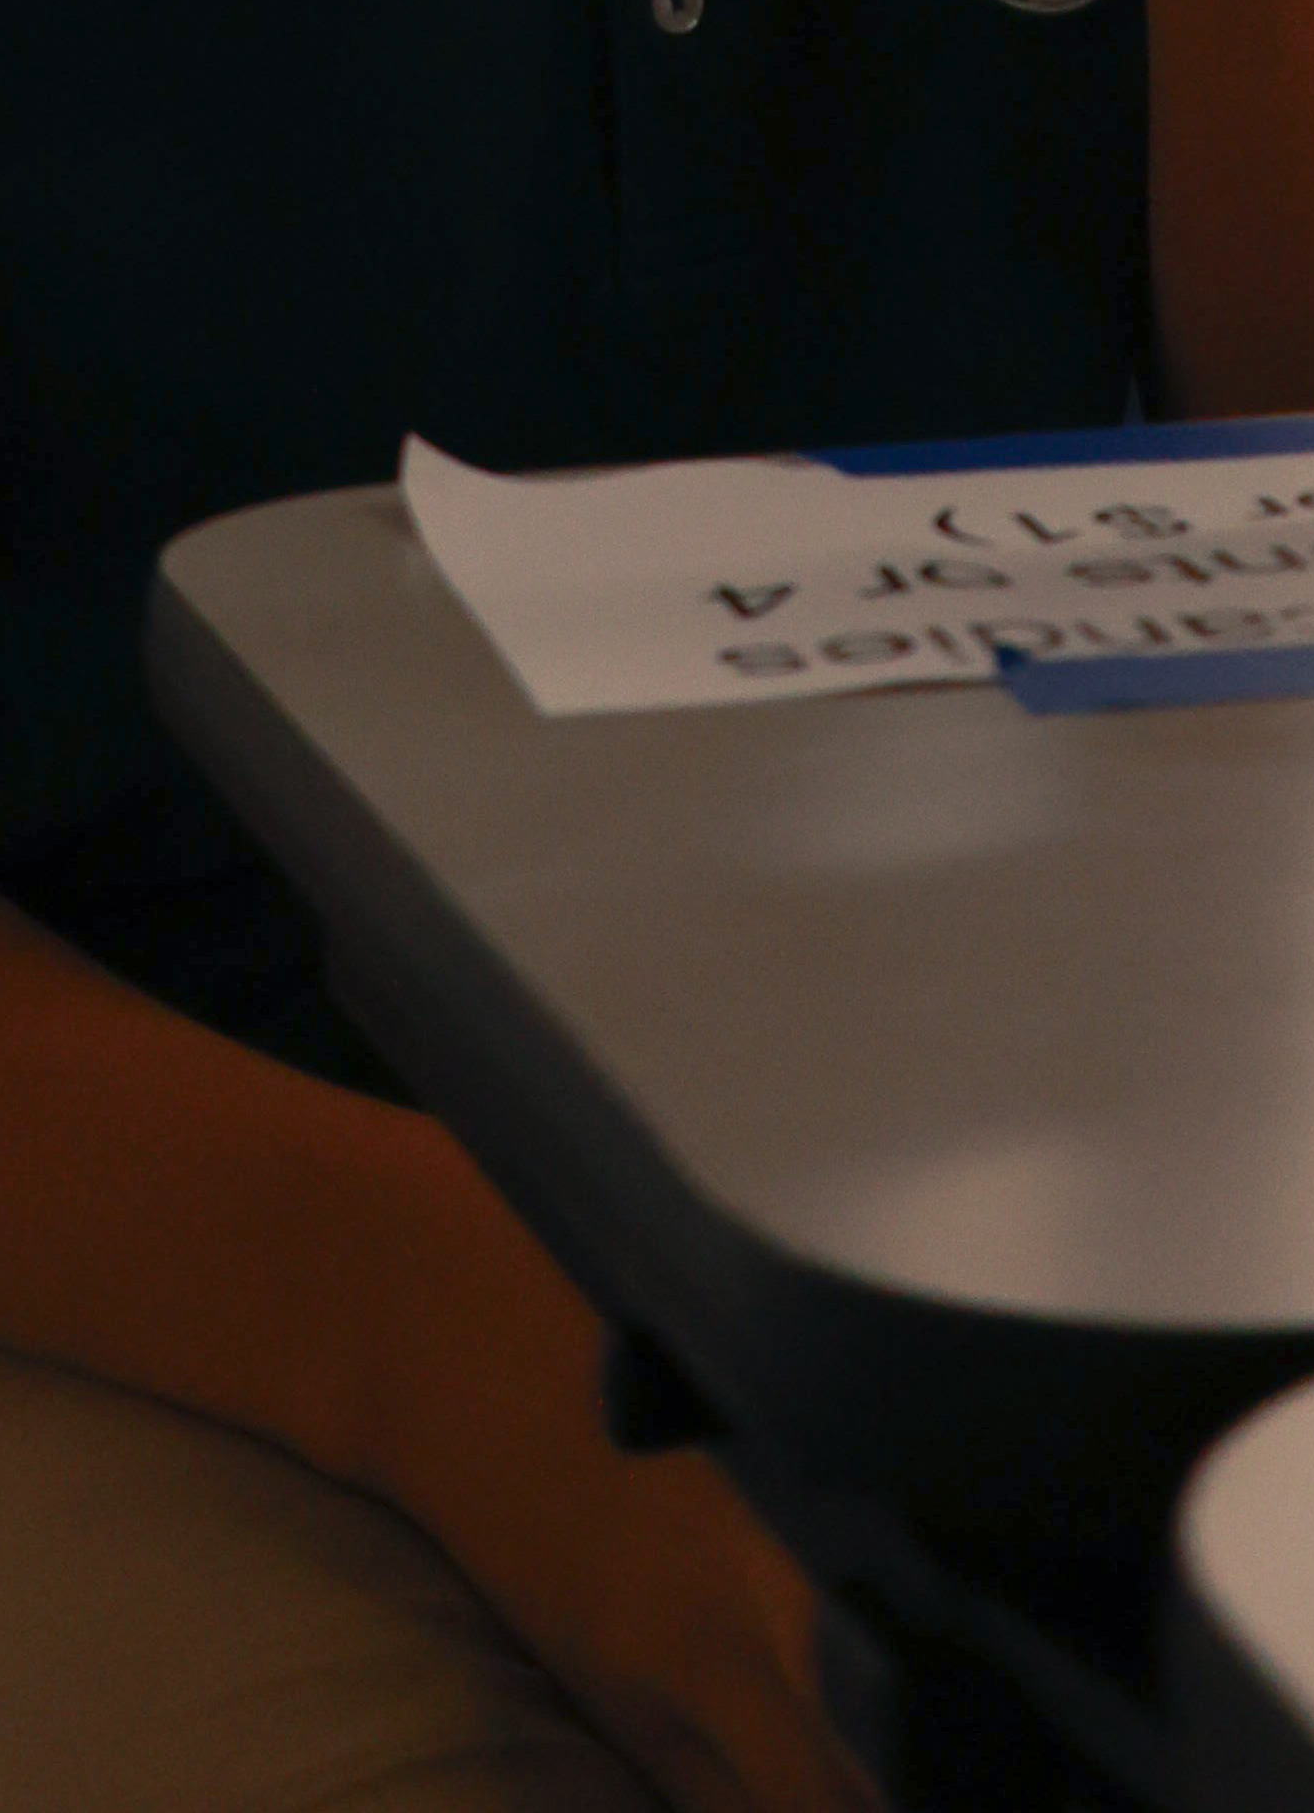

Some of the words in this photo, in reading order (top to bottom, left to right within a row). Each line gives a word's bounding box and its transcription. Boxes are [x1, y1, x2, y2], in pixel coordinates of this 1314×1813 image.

[931, 503, 1191, 547] $1)
[859, 560, 1011, 599] or
[709, 581, 795, 619] 4
